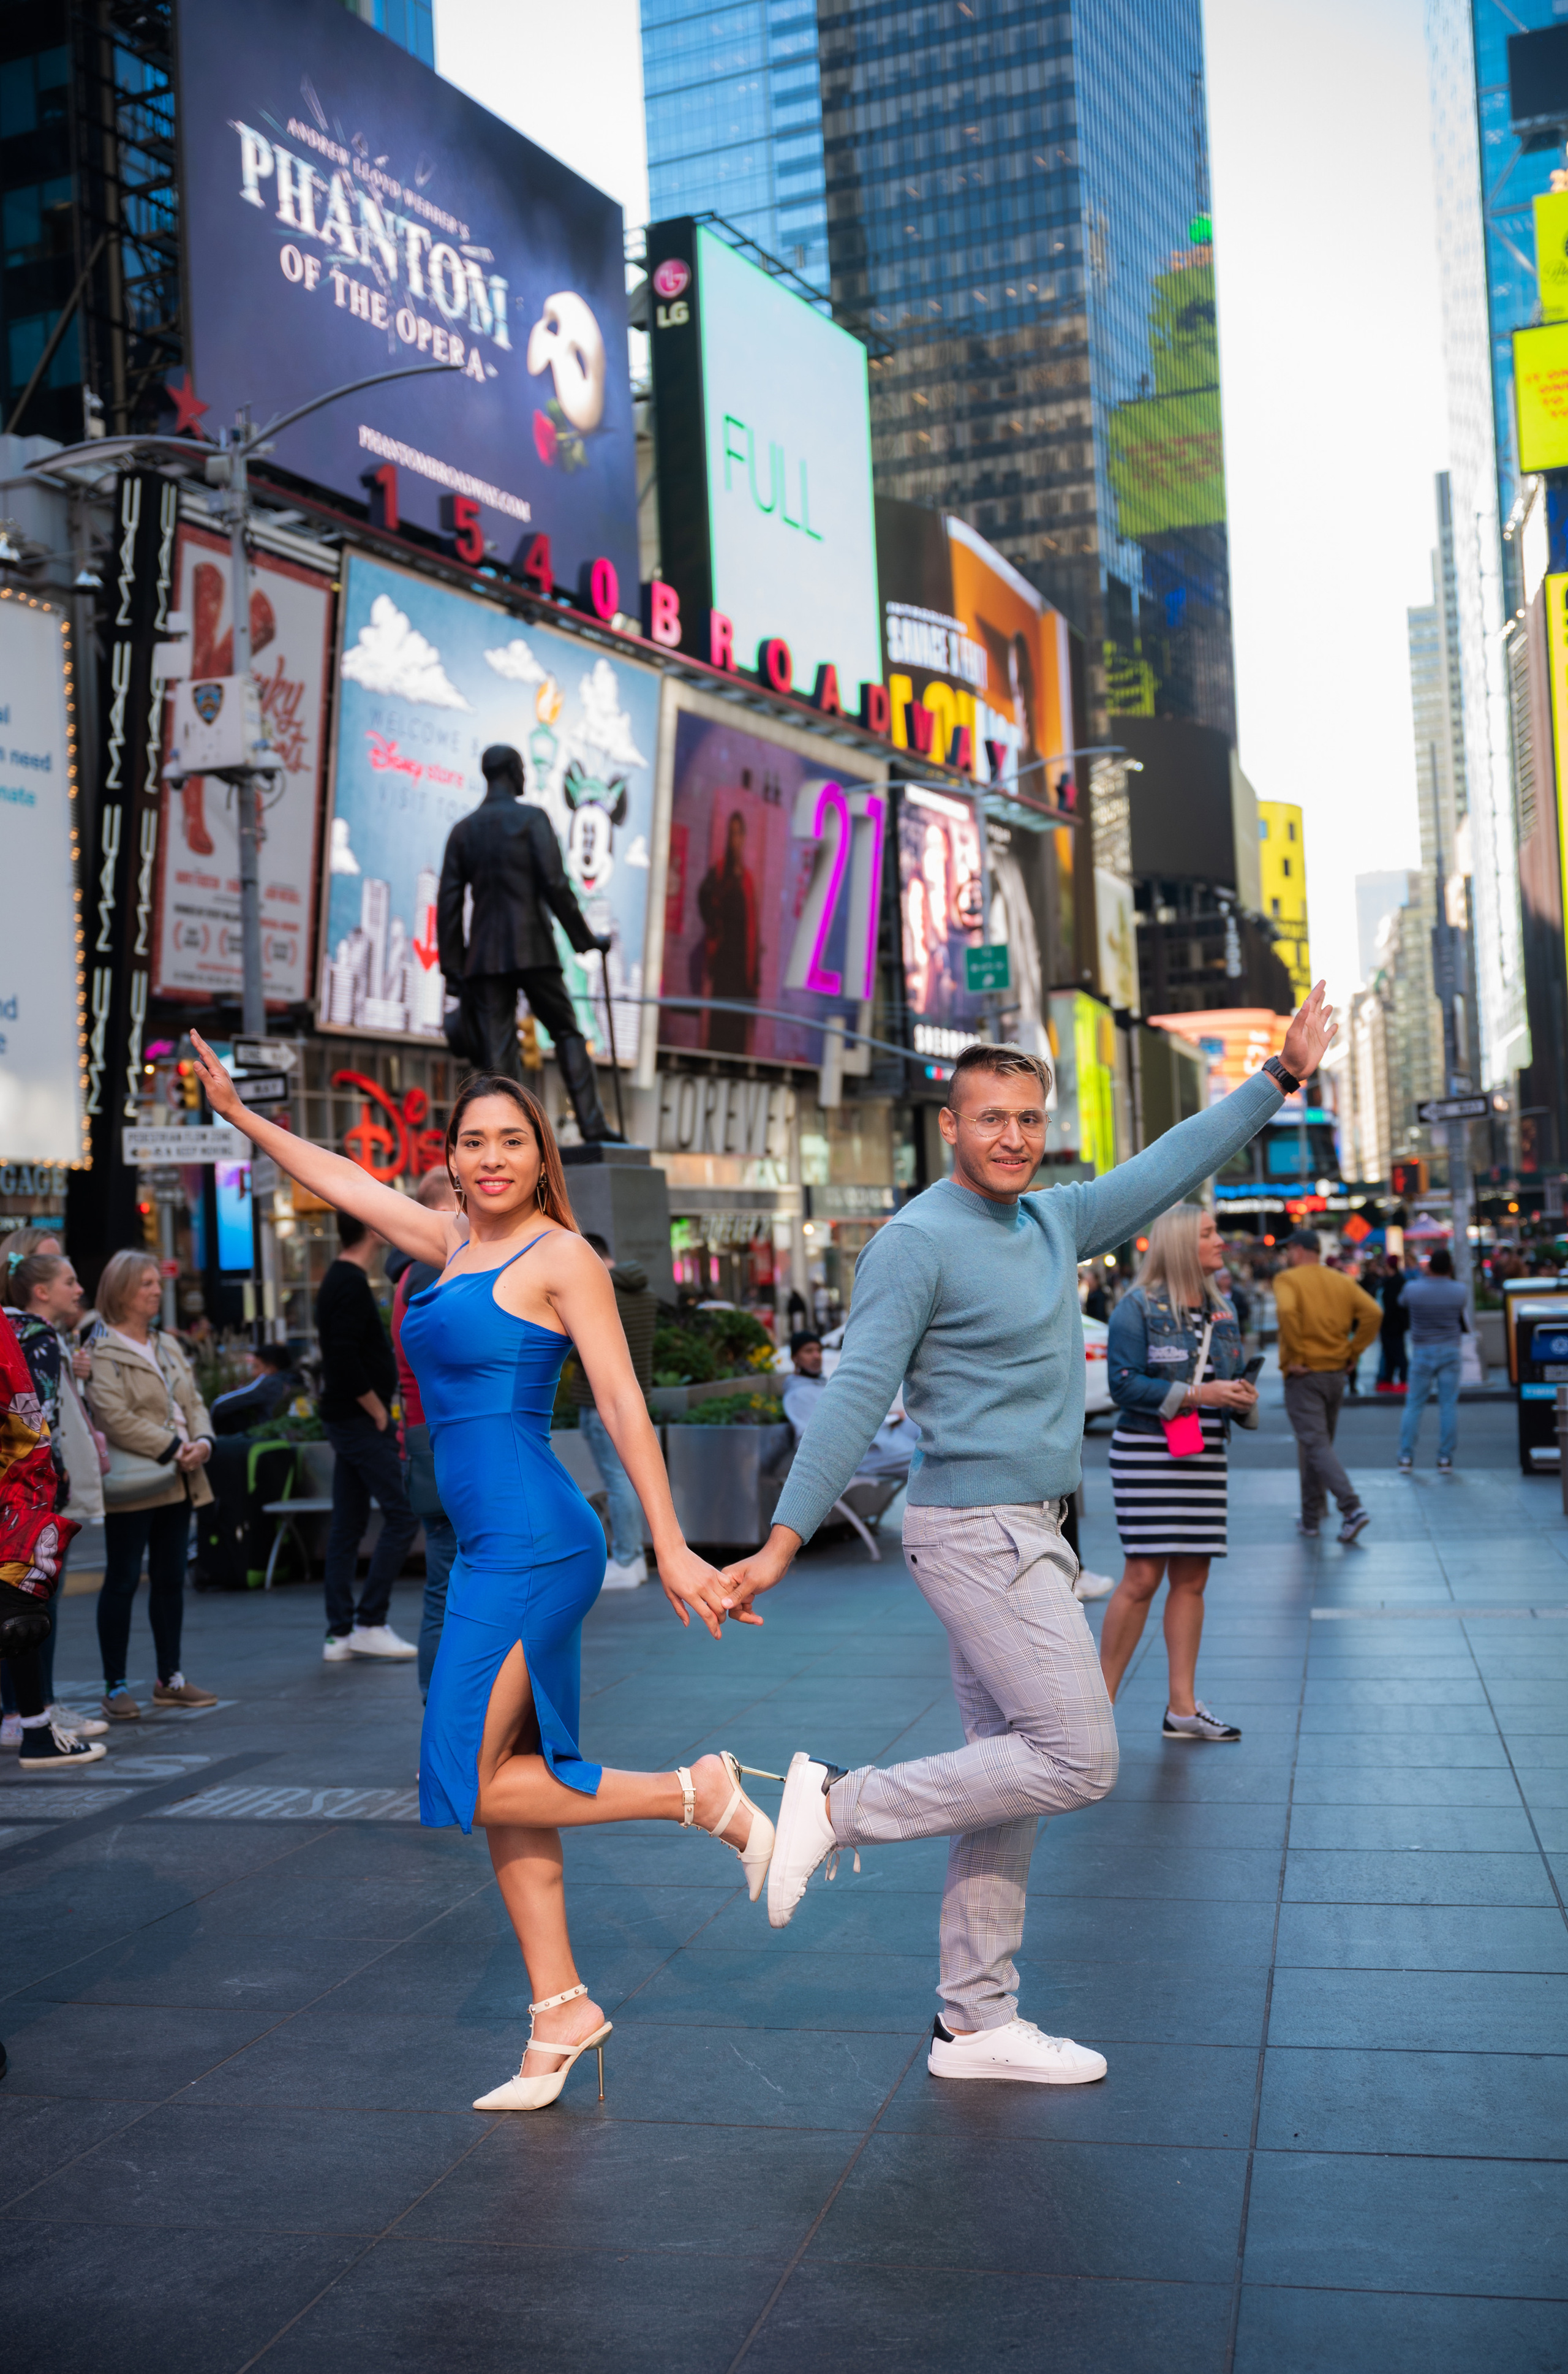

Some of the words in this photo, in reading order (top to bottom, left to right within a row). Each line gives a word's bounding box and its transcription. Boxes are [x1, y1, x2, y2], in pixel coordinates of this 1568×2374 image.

[287, 117, 351, 167] ANDREW
[353, 156, 402, 199] LLOYD
[230, 120, 513, 351] PHANTOM
[279, 244, 322, 292] OF
[329, 268, 390, 331] THE
[396, 308, 486, 384] OPERA
[657, 301, 690, 329] LG
[722, 412, 823, 543] FULL
[368, 463, 619, 620] 1540
[649, 594, 1008, 783] BROADWAY
[795, 778, 886, 1001] 21
[654, 1074, 796, 1155] FOREVER
